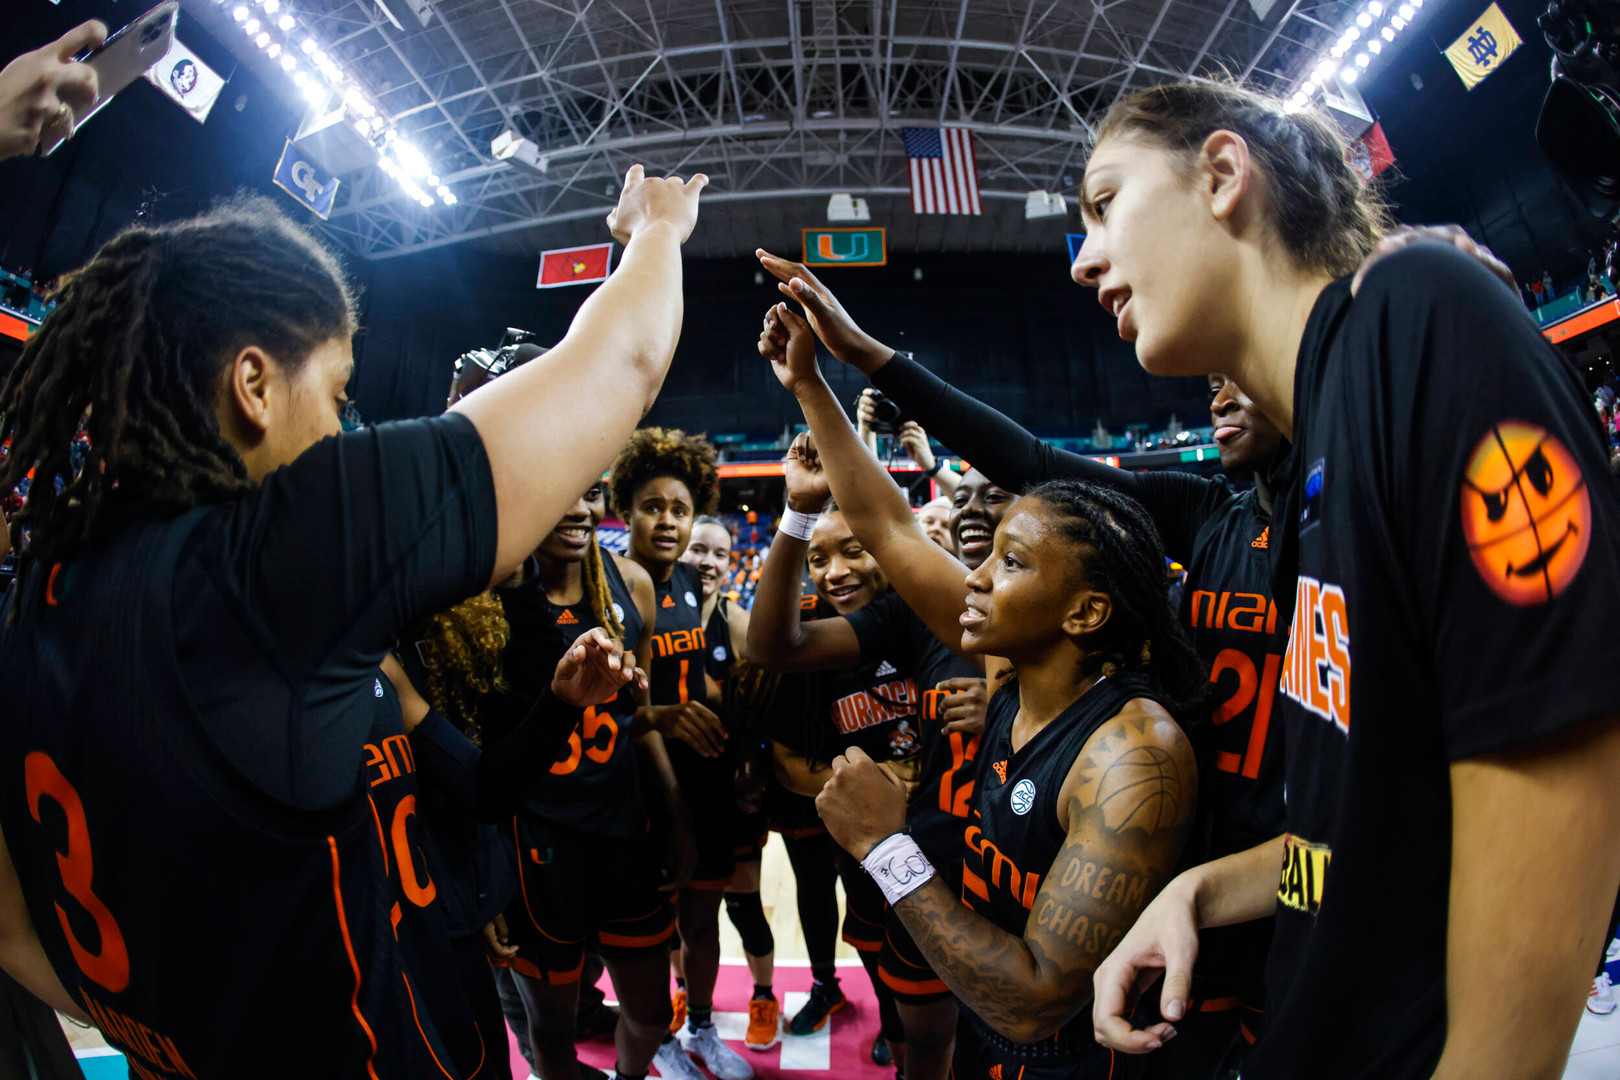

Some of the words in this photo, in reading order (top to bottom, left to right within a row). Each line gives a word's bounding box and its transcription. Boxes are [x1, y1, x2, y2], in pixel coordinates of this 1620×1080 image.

[291, 160, 324, 203] GT
[817, 233, 868, 261] U
[678, 659, 689, 704] 1
[1209, 647, 1281, 780] 21
[1015, 789, 1033, 804] ACC
[24, 751, 130, 994] 3
[529, 847, 554, 865] U
[1061, 857, 1149, 910] DREAM
